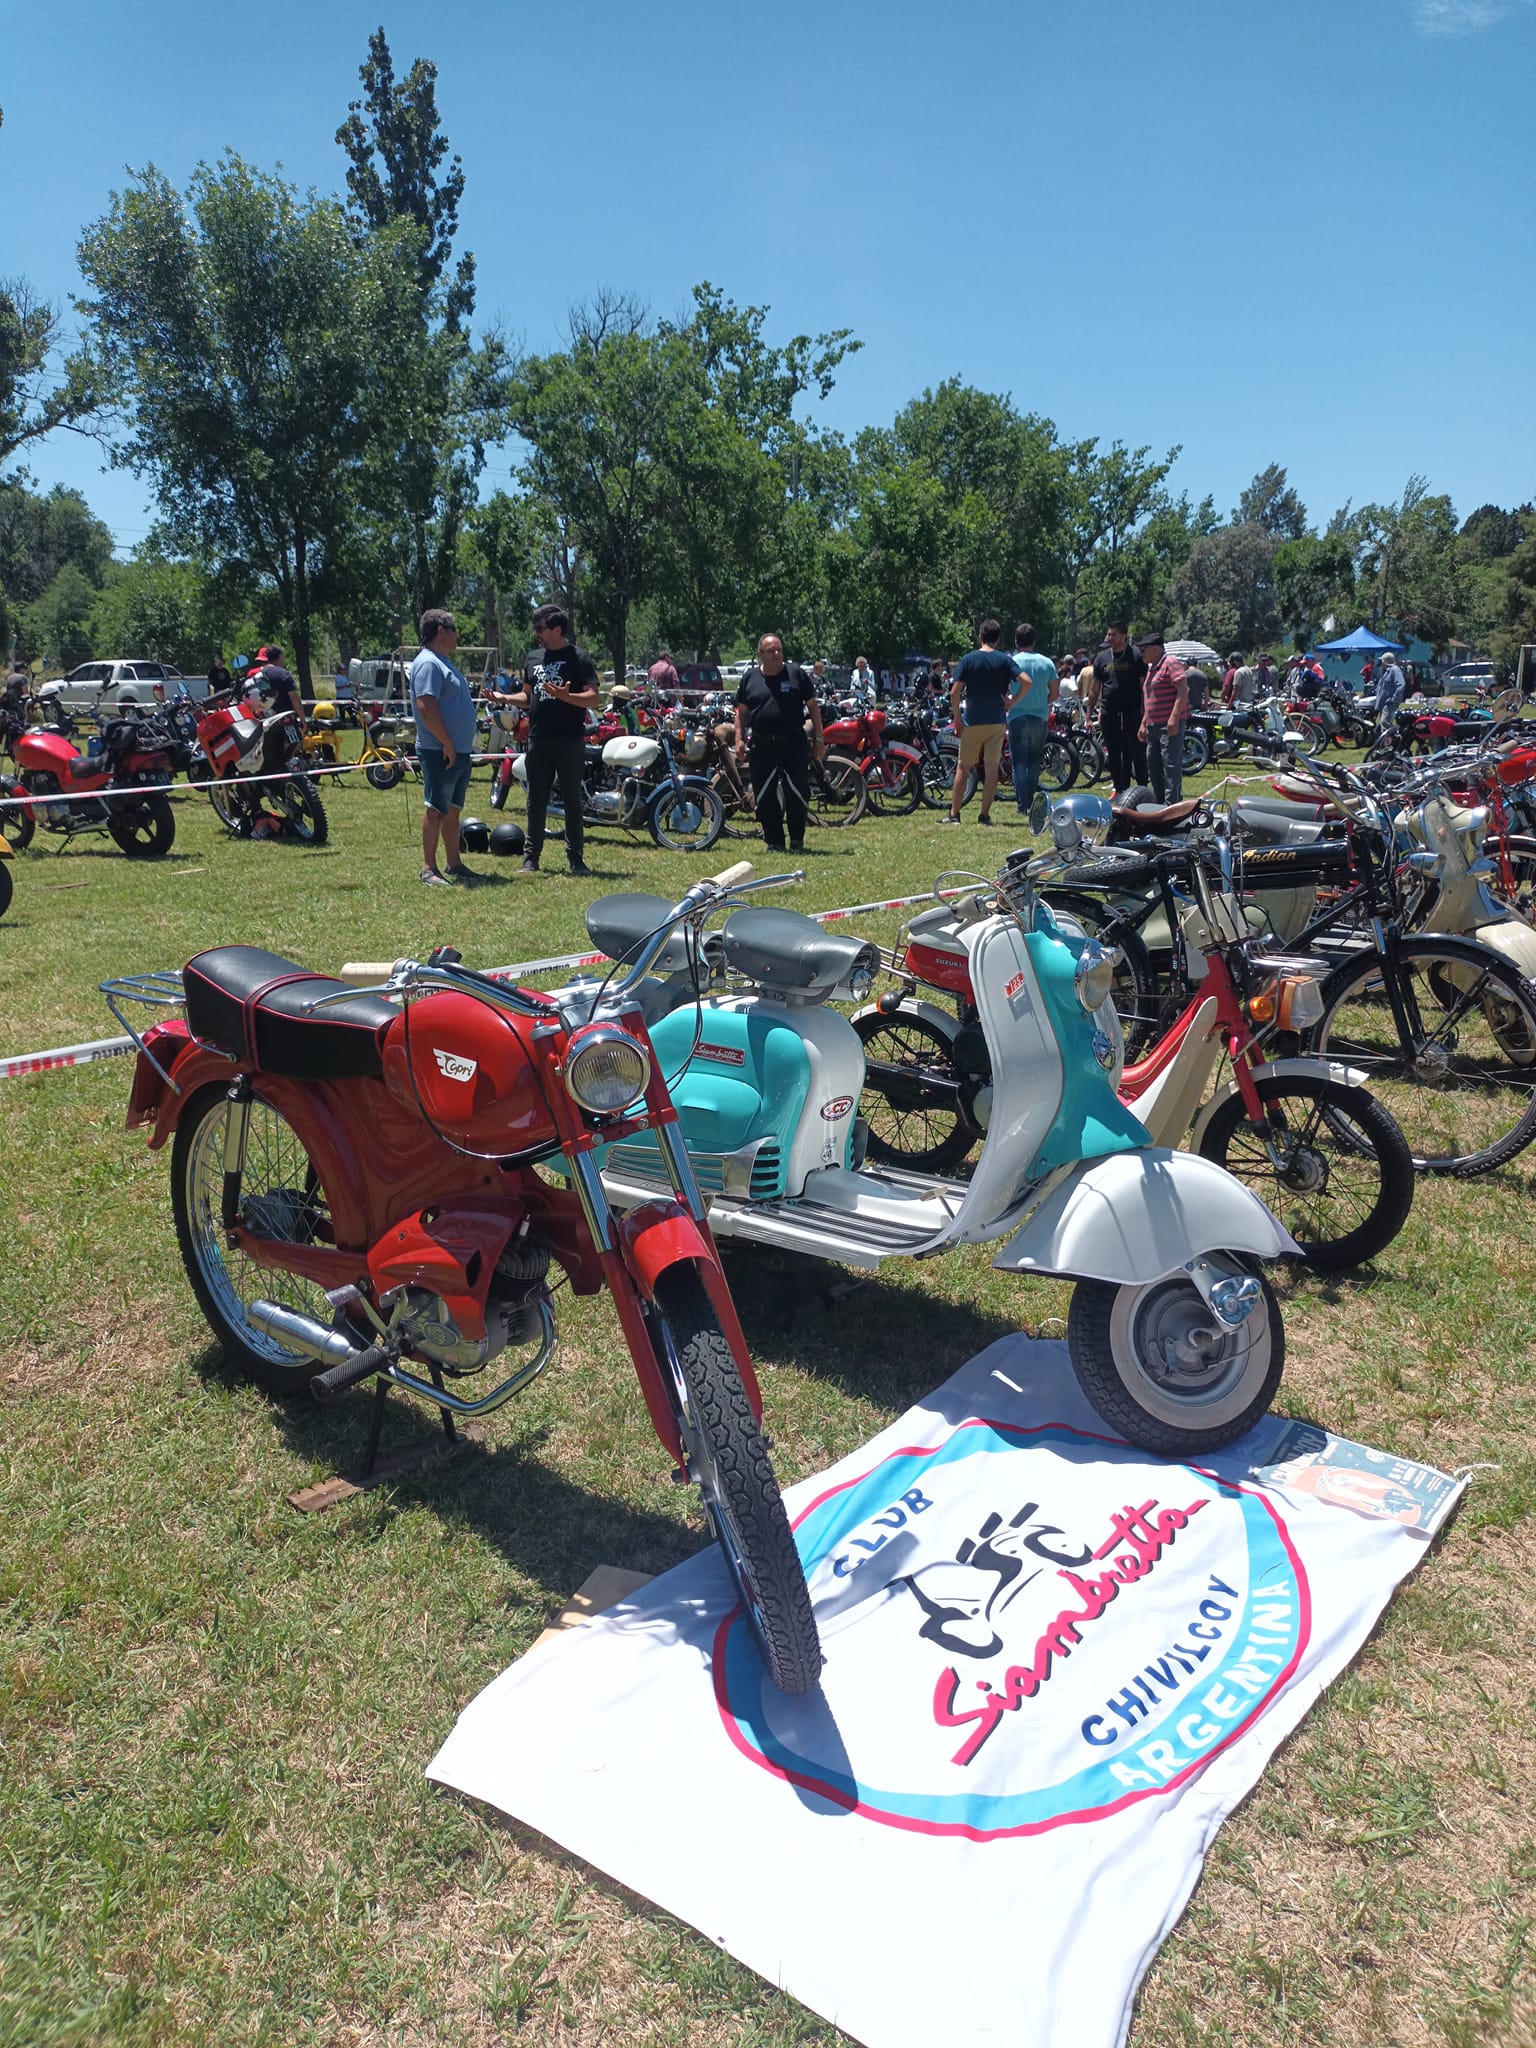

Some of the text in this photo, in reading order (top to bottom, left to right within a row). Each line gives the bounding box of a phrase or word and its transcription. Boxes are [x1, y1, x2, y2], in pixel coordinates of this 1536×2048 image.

[1237, 849, 1297, 865] Indian
[935, 957, 962, 969] SUZUKI
[443, 1054, 473, 1077] Capri
[833, 1488, 934, 1578] CLUB
[933, 1499, 1210, 1766] Siambretta
[1081, 1574, 1239, 1746] CHIVILCOY
[1108, 1579, 1292, 1786] ARGENTINA
